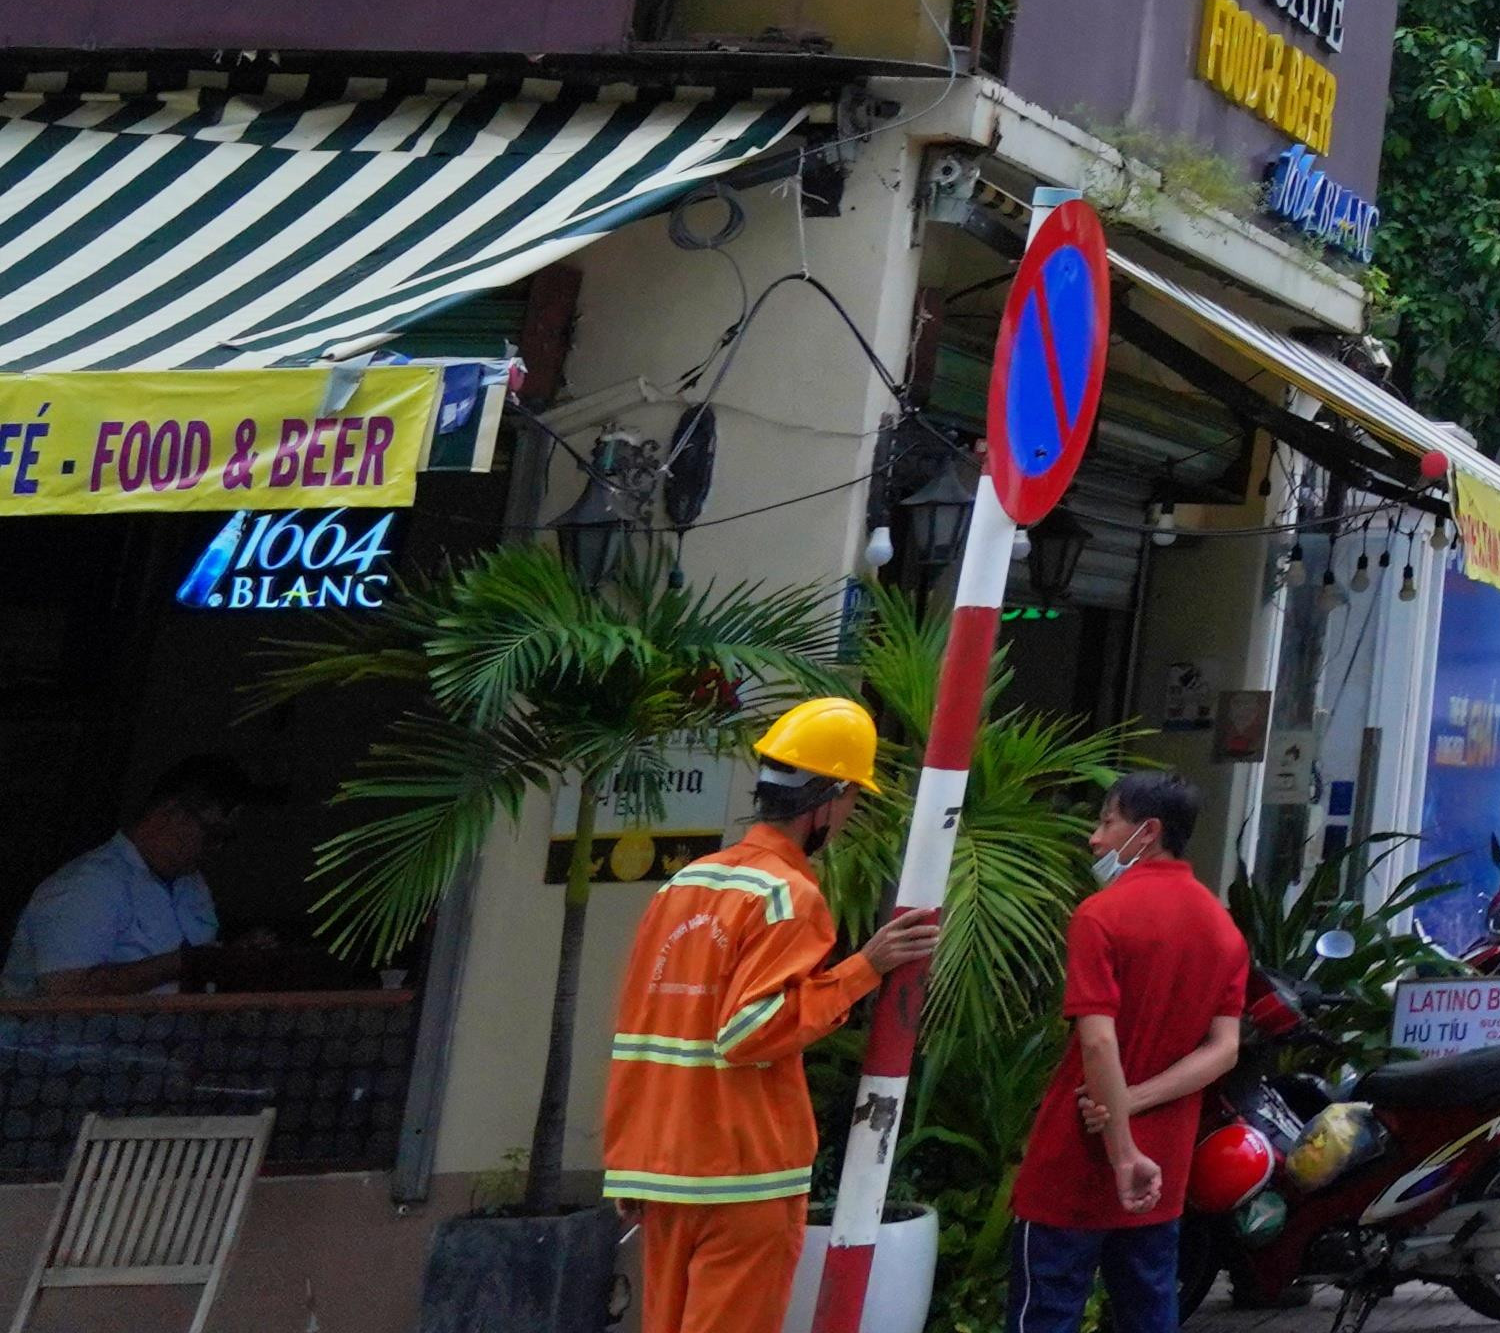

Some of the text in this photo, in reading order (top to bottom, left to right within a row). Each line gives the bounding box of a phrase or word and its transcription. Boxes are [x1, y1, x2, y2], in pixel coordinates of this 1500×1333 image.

[1284, 44, 1337, 158] BEER
[90, 419, 212, 493] FOOD
[222, 418, 258, 491] &
[269, 415, 394, 489] BEER
[235, 507, 395, 574] 1664
[228, 575, 389, 609] BLANC
[1409, 988, 1481, 1013] LATINO
